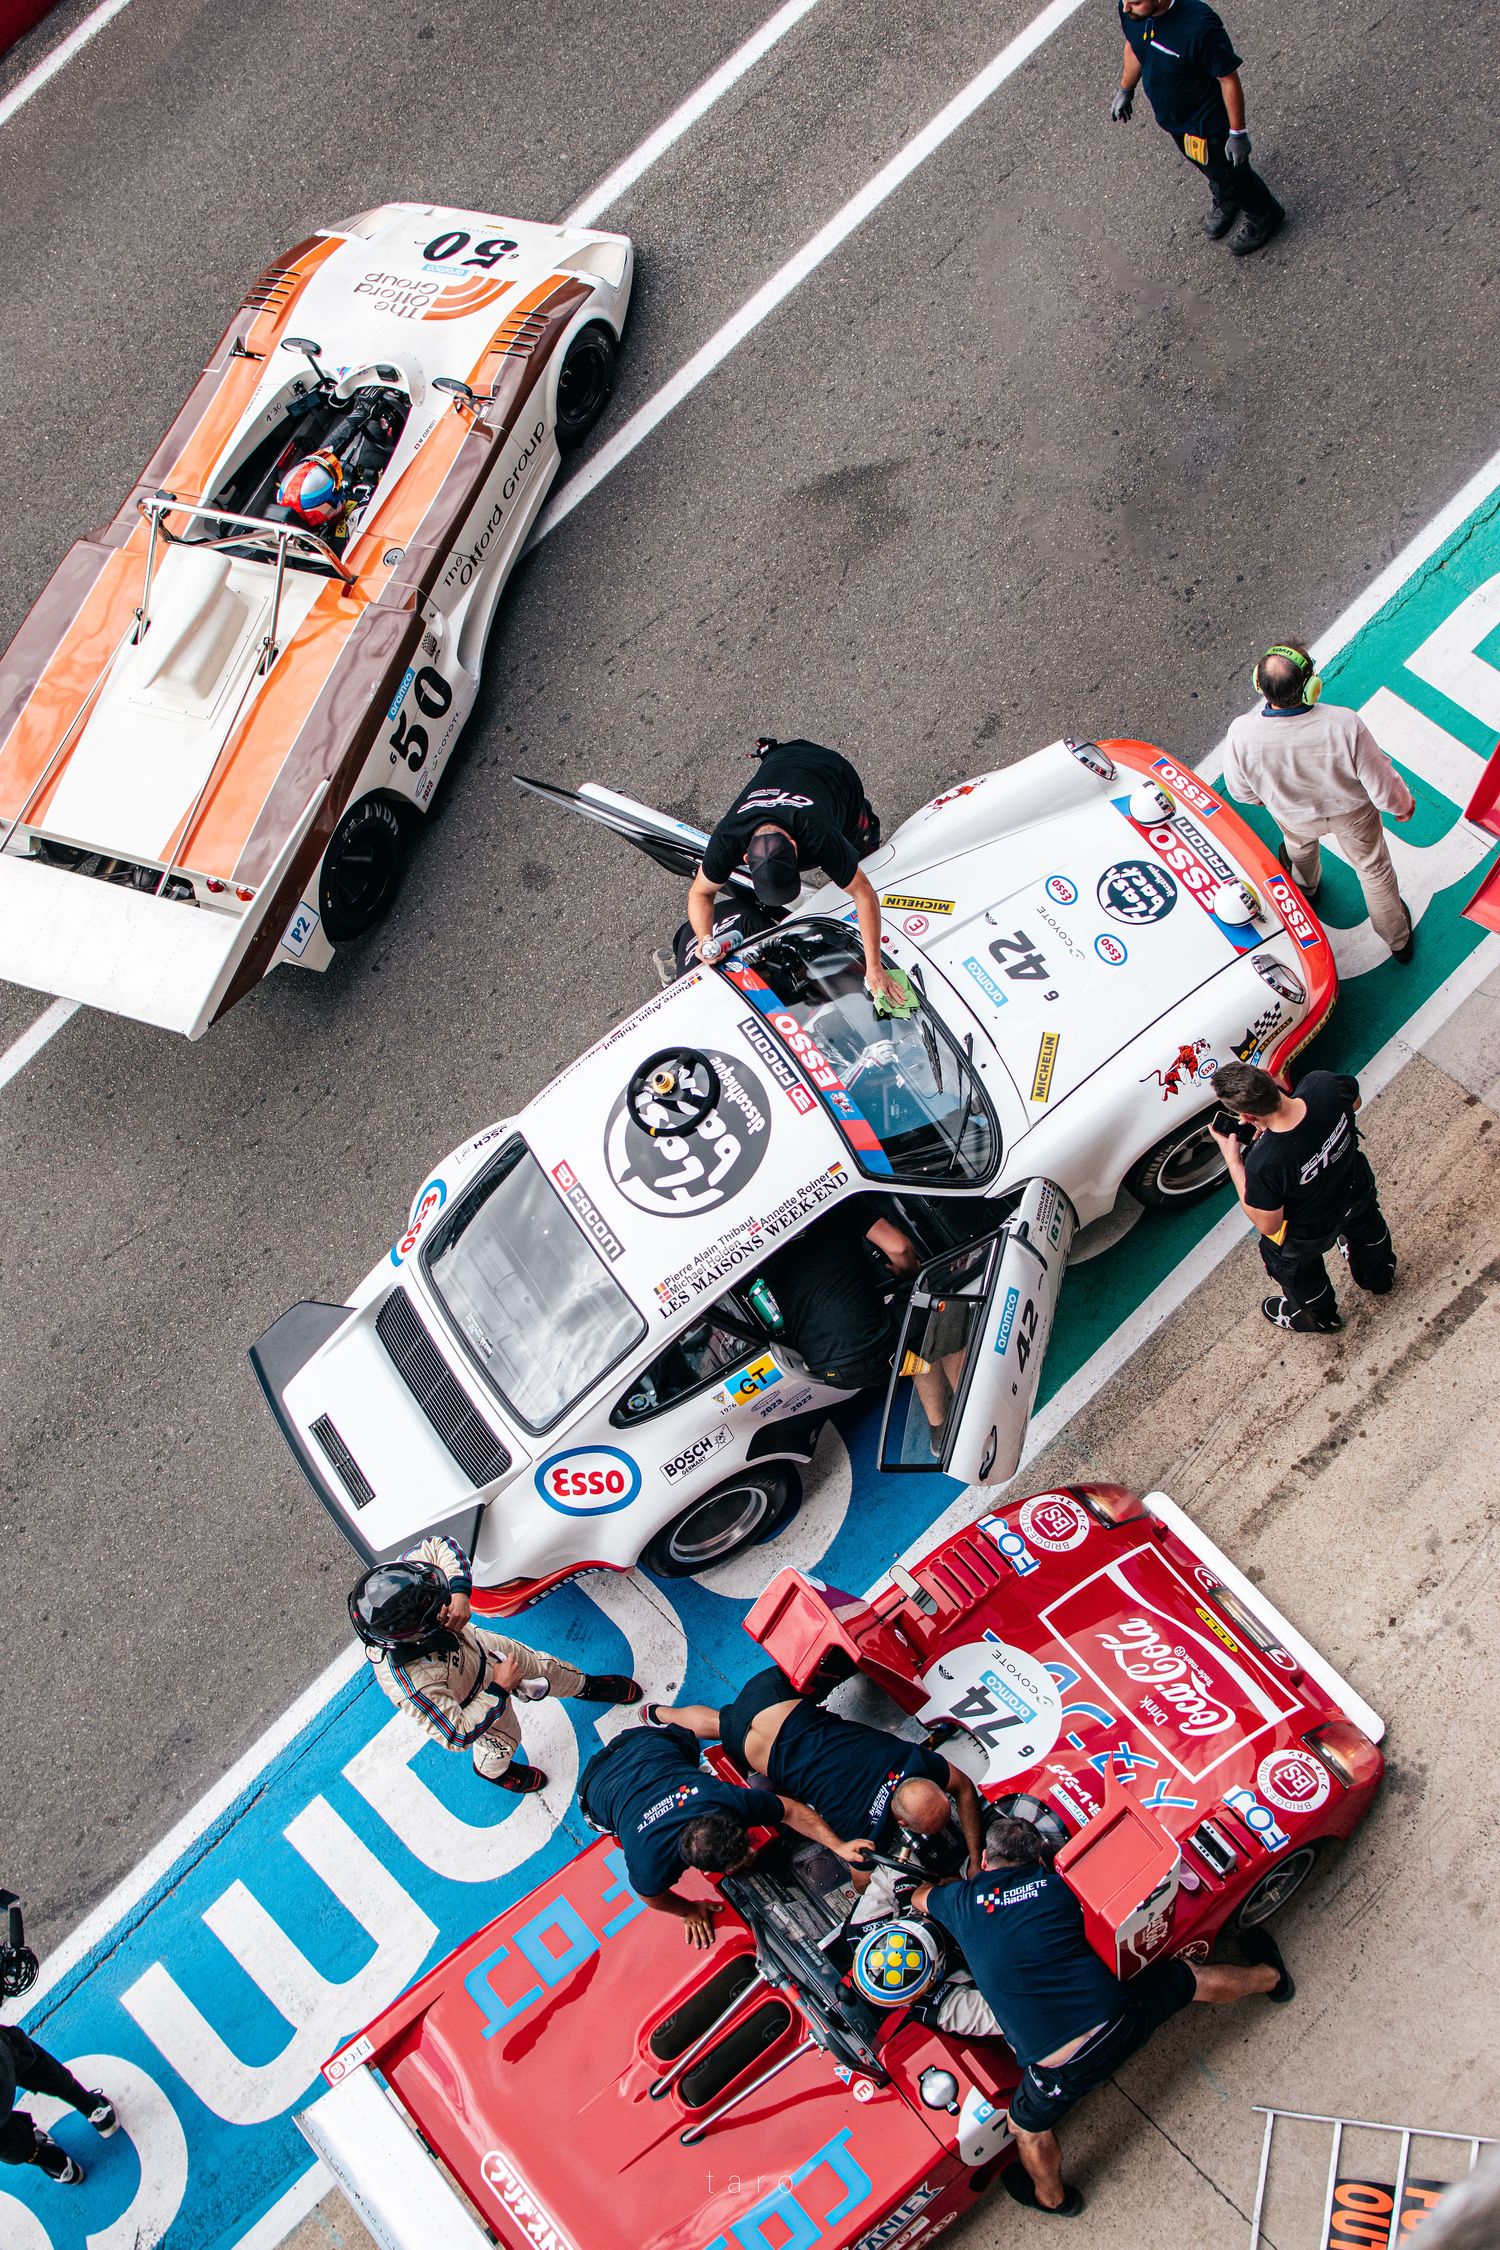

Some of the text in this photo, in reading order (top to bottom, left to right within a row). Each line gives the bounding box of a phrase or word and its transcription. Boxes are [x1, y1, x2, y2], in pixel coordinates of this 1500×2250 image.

[423, 231, 518, 269] 50
[365, 272, 439, 294] Group
[374, 301, 418, 320] The
[443, 556, 463, 587] The
[503, 421, 545, 500] Group
[390, 671, 413, 717] aramco
[389, 666, 452, 772] 50
[1160, 765, 1213, 810] ESSO
[1149, 828, 1221, 911] ESSO
[1175, 816, 1234, 879] FACOM
[886, 897, 950, 911] MICHELIN
[1036, 905, 1073, 949] COYOTE
[1272, 884, 1314, 939] ESSO
[290, 916, 311, 944] P2
[988, 930, 1050, 980] 42
[967, 961, 1004, 1003] aramco
[1043, 990, 1060, 1001] 6
[741, 1022, 796, 1087] FACOM
[775, 1015, 840, 1088] ESSO
[1035, 1035, 1056, 1098] MICHELIN
[710, 1056, 766, 1136] discotheque
[569, 1188, 624, 1260] FACOM
[759, 1196, 798, 1227] Annette
[764, 1171, 849, 1237] WEEK-END
[1050, 1199, 1065, 1242] GT1
[663, 1216, 756, 1289] Pierre Alain Thibaut
[669, 1240, 742, 1296] Michael Holden
[658, 1234, 764, 1319] LES MAISONS
[997, 1293, 1017, 1349] aramco
[1016, 1298, 1040, 1374] 42
[739, 1367, 768, 1395] GT
[790, 1394, 814, 1413] 2022
[719, 1403, 737, 1416] 1976
[760, 1398, 784, 1418] 2023
[663, 1437, 714, 1479] BOSCH
[681, 1456, 707, 1476] GERMANY
[1020, 1501, 1070, 1550] BRIDGESTONE
[1044, 1507, 1070, 1530] BS
[976, 1518, 1041, 1576] FOJ
[991, 1649, 1038, 1695] COYOTE
[1095, 1617, 1236, 1736] Coca-Cola
[949, 1686, 1025, 1750] 74
[985, 1675, 1031, 1719] aramco
[1139, 1694, 1169, 1727] Drink
[1017, 1744, 1036, 1758] 6
[1259, 1760, 1313, 1811] BRIDGESTONE
[1283, 1764, 1312, 1791] BS
[1222, 1790, 1290, 1851] FOJ
